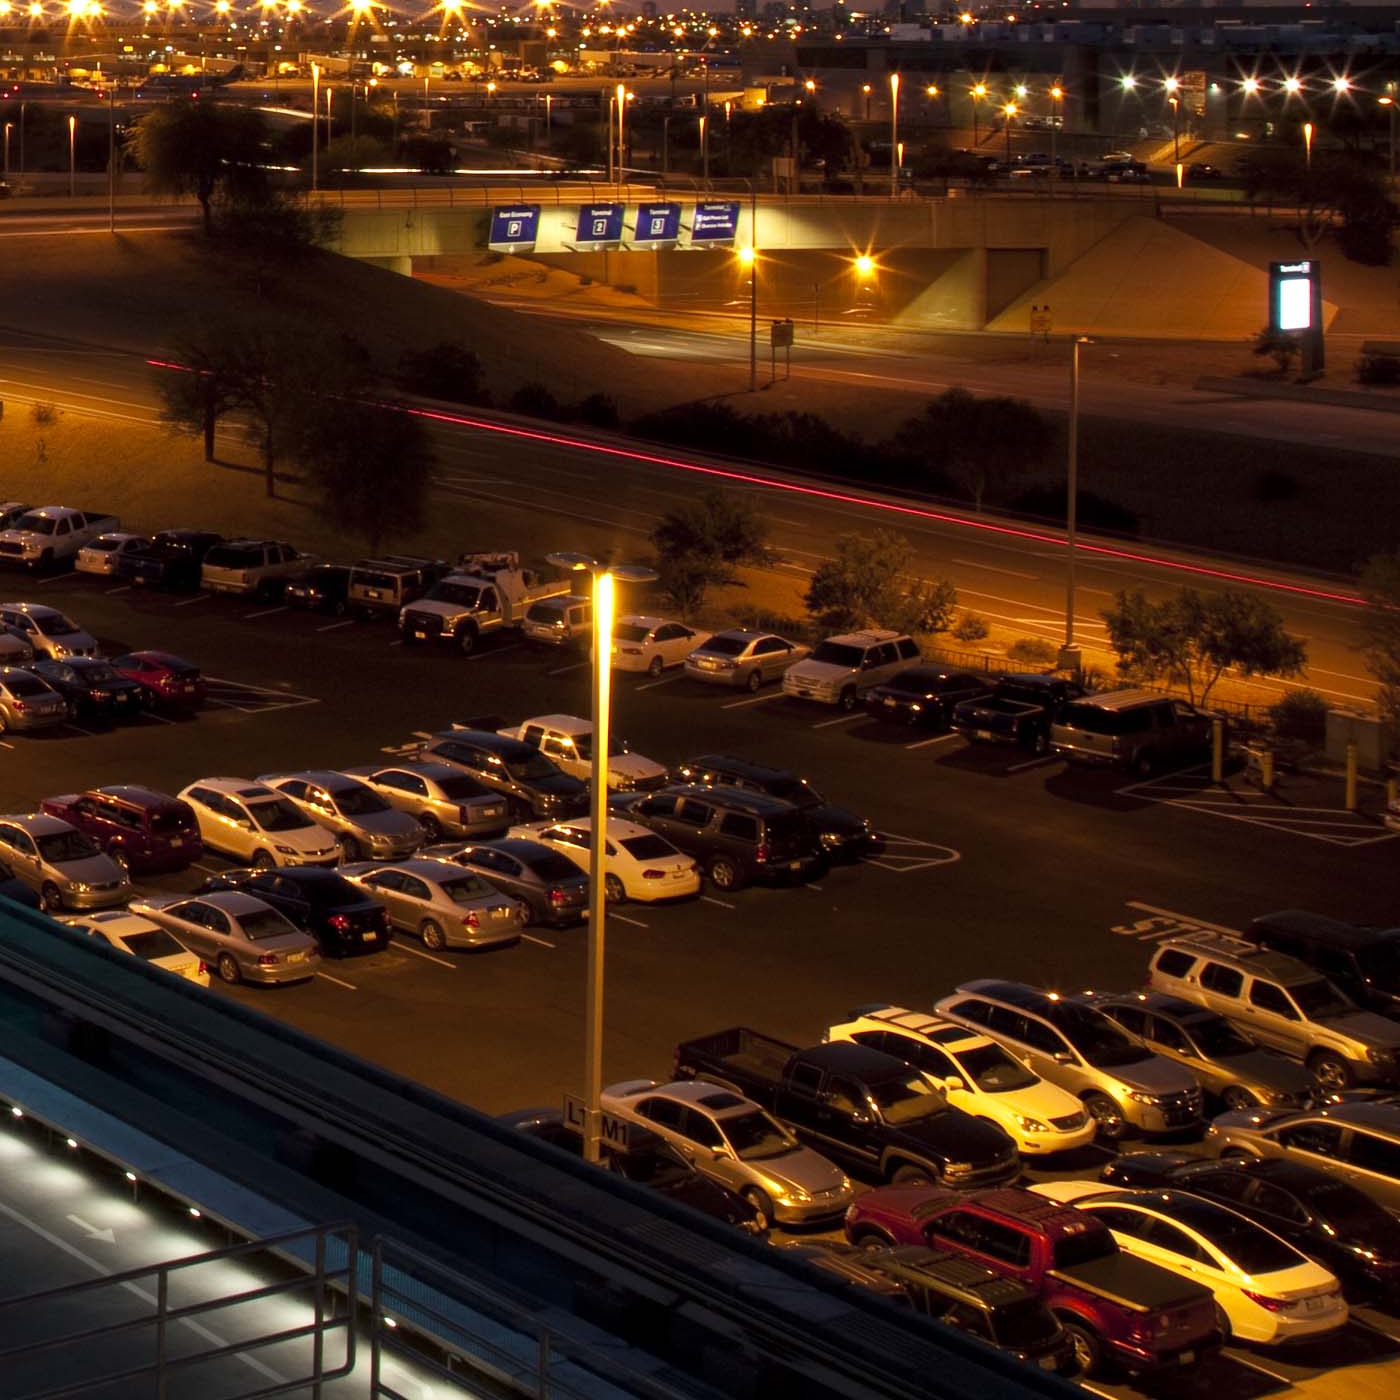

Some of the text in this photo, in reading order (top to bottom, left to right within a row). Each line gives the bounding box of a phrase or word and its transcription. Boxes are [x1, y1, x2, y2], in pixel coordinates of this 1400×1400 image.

[511, 223, 518, 234] P
[569, 1102, 585, 1127] L1
[602, 1115, 626, 1145] M1
